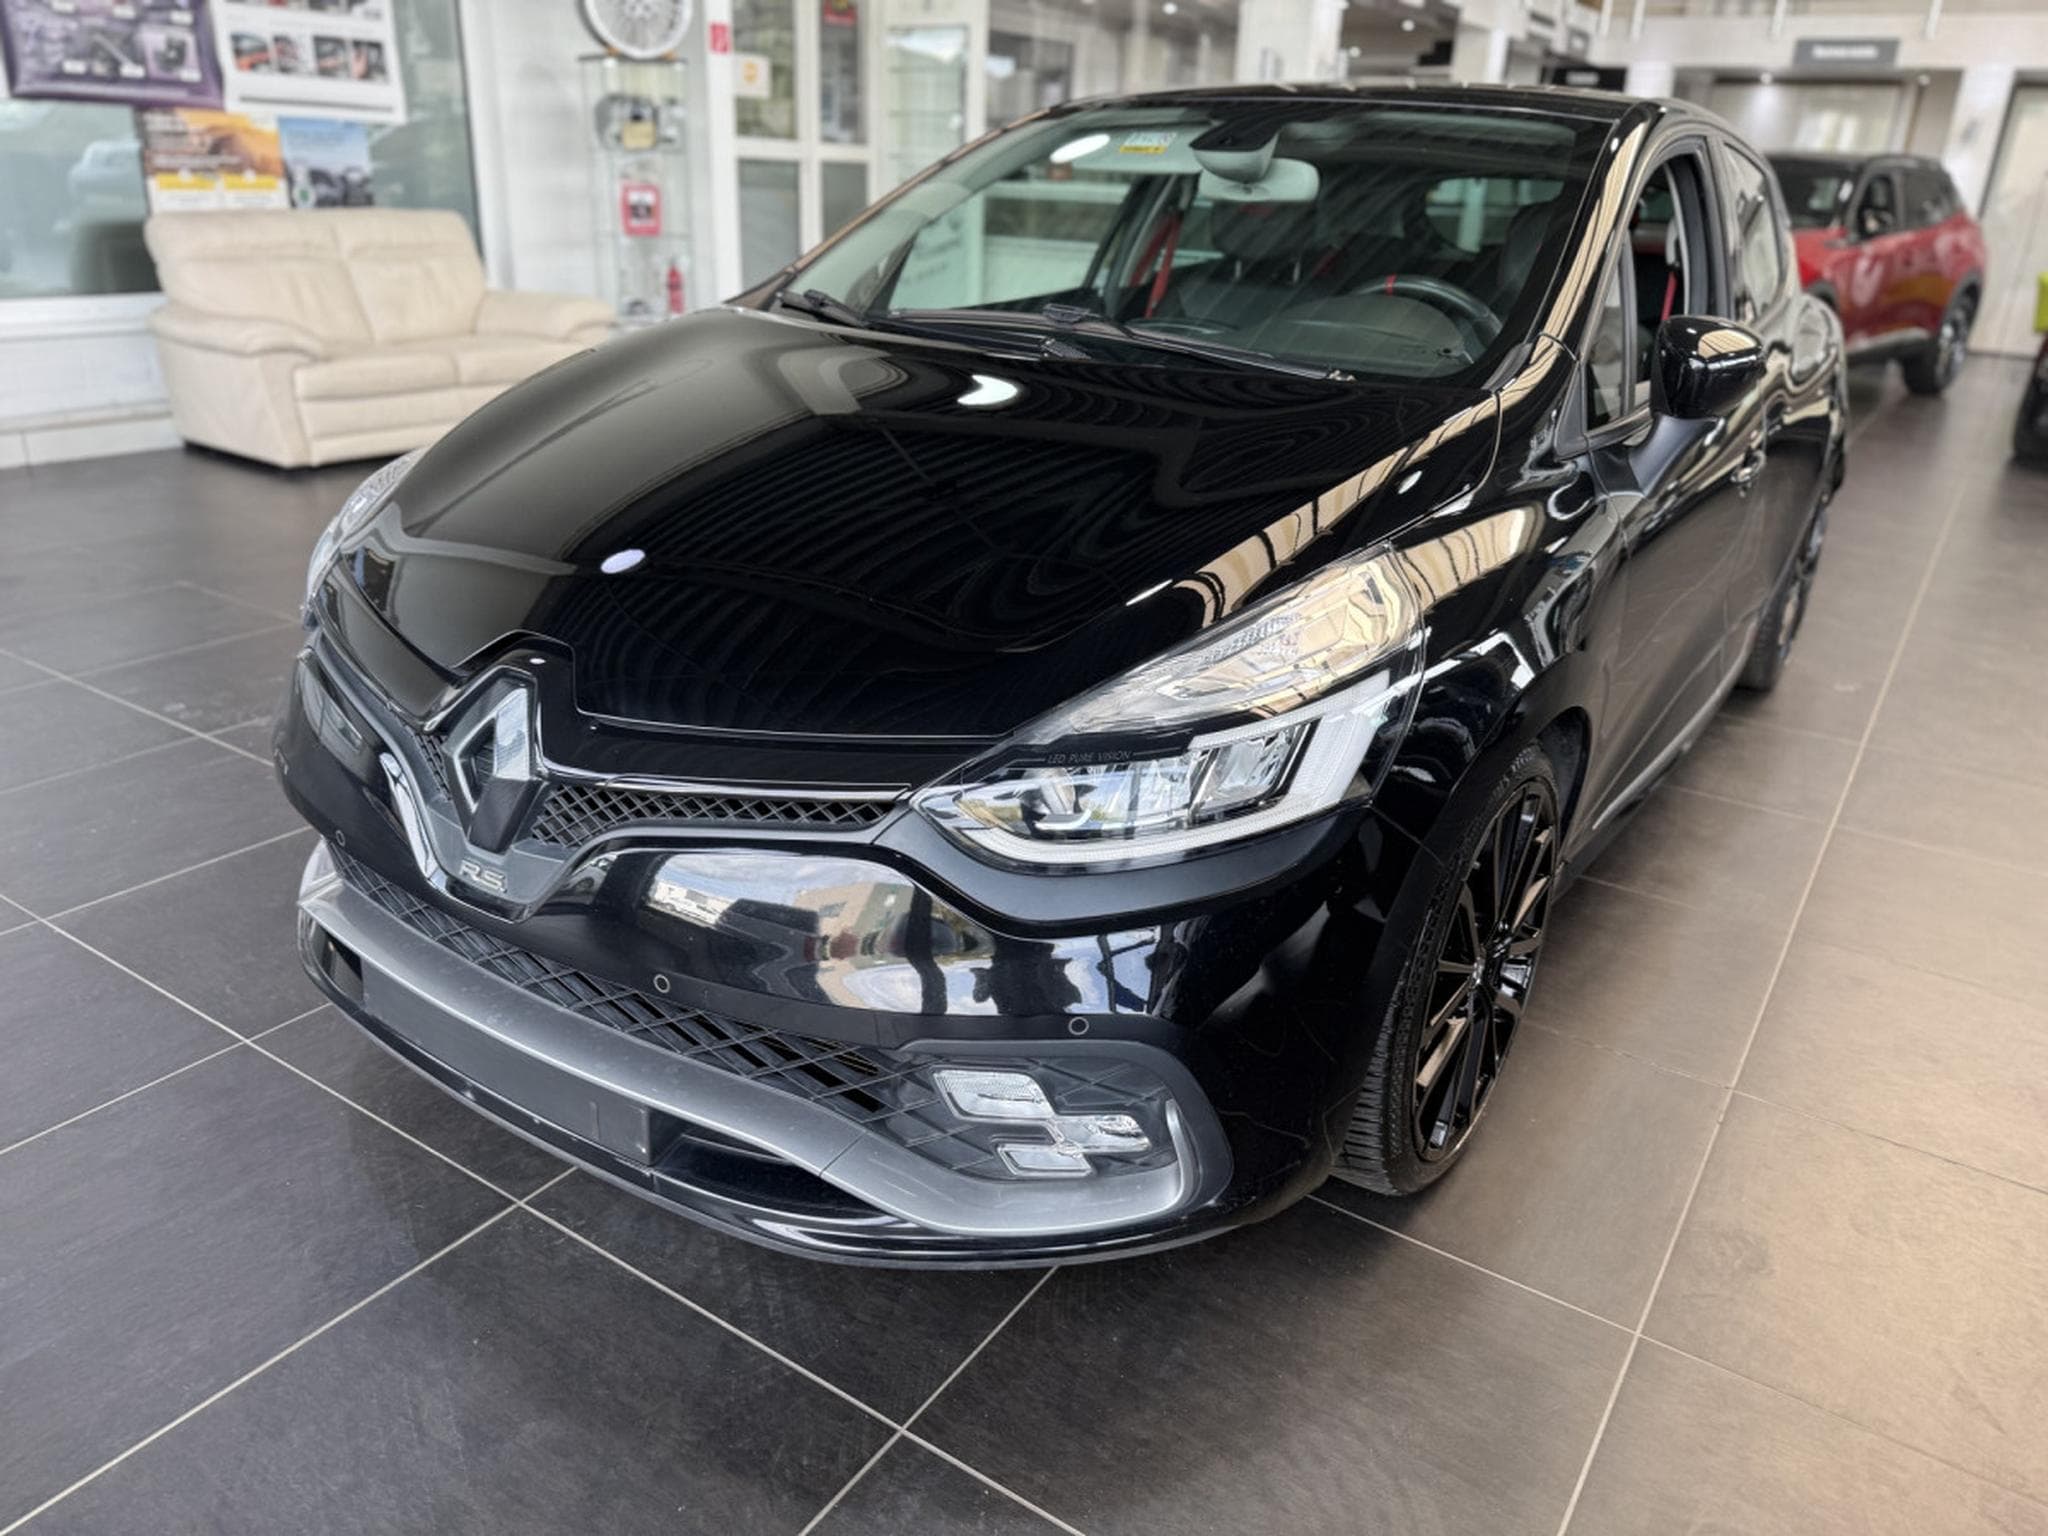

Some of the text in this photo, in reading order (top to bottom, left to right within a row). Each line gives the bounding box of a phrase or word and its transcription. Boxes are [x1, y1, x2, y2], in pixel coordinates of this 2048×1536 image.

[1047, 750, 1132, 764] LED PURE VISION
